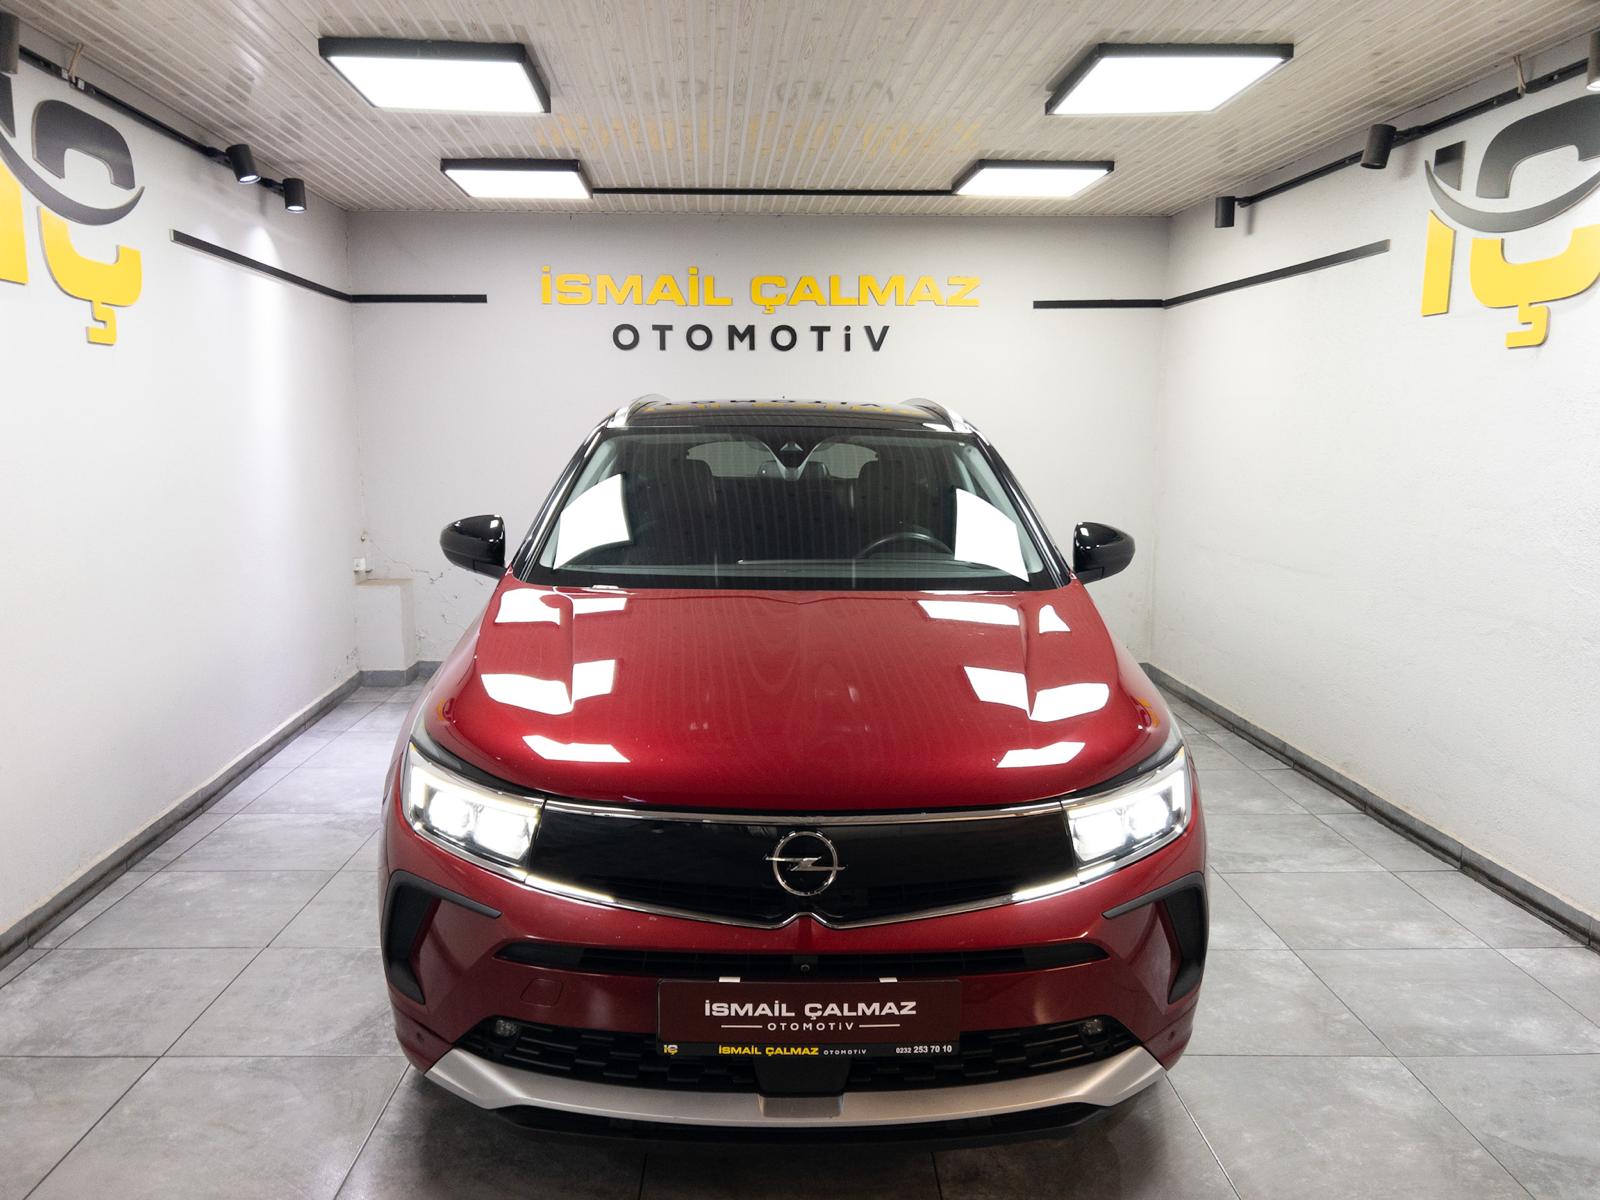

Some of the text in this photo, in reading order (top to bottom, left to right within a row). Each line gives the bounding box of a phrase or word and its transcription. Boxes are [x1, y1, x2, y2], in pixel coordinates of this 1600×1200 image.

[540, 265, 982, 314] İSMAİL ÇALMAZ
[704, 1000, 917, 1020] İSMAİL ÇALMAZ
[718, 1044, 762, 1055] İSMAİL
[765, 1047, 819, 1056] ÇALMAZ
[913, 1045, 928, 1054] 253
[930, 1045, 940, 1053] 70
[942, 1045, 953, 1053] 10
